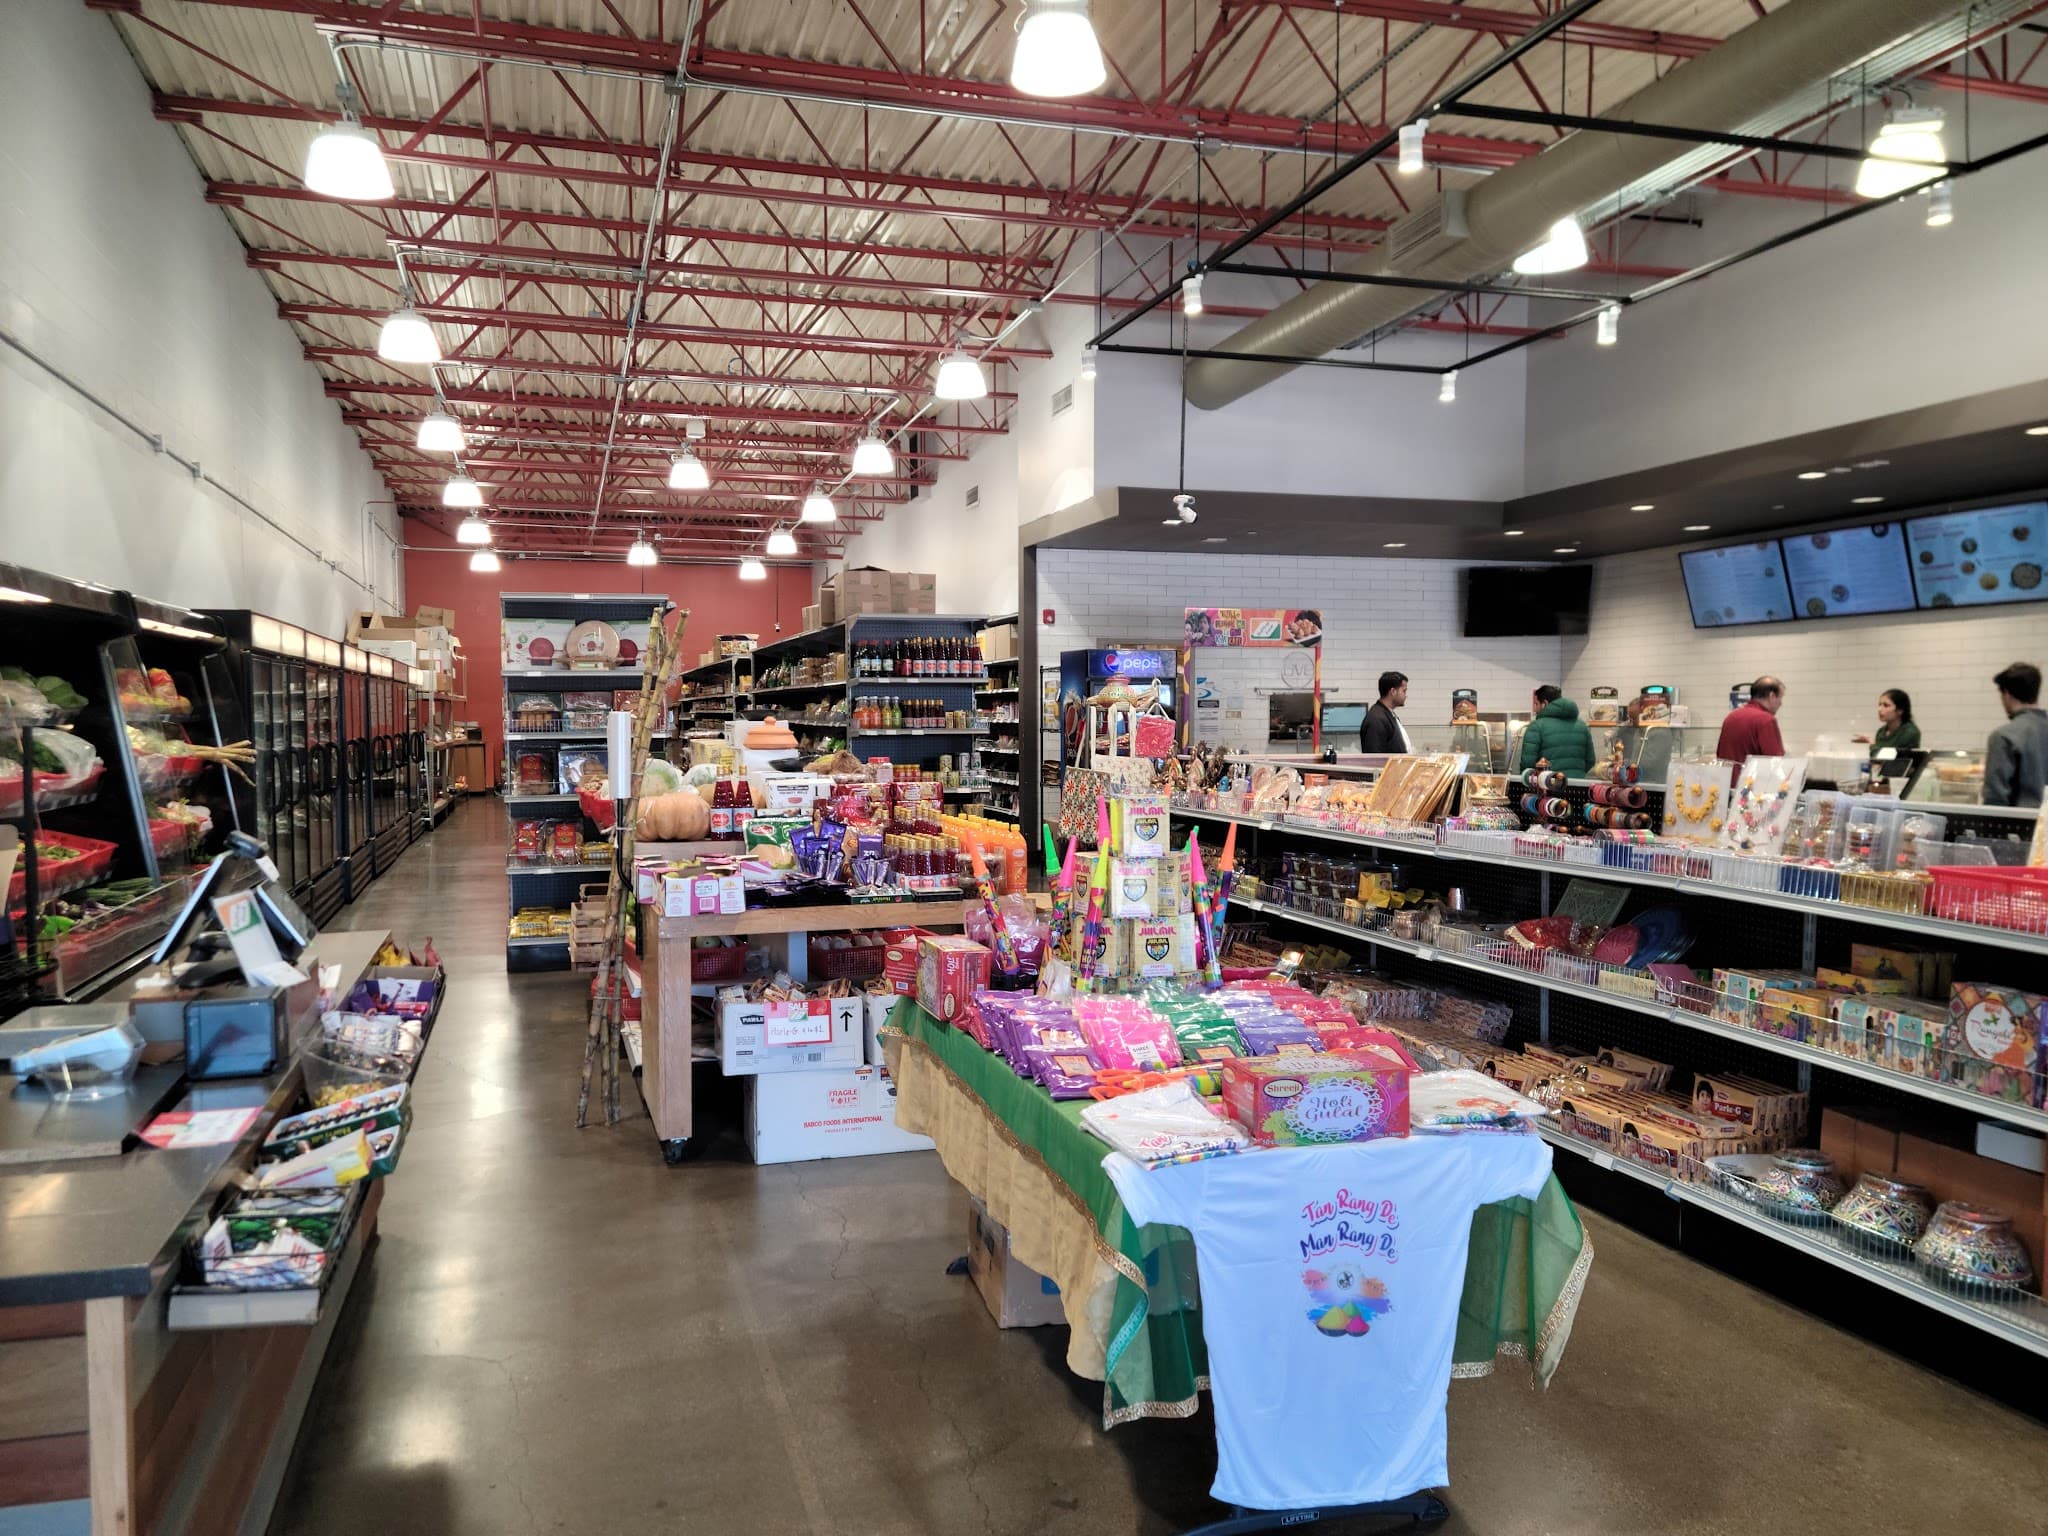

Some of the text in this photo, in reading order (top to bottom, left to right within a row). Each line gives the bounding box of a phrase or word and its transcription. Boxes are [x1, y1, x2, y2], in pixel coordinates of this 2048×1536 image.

[1122, 656, 1161, 671] pepsi
[788, 1002, 809, 1010] SALE
[829, 1089, 857, 1097] FRAGILE
[1267, 1083, 1300, 1095] Shreeji
[1309, 1095, 1352, 1108] Holi
[842, 1115, 882, 1124] INTERNATIONAL
[1305, 1106, 1362, 1121] Gulal
[1303, 1188, 1396, 1225] Tan Rang De
[1300, 1221, 1396, 1259] Man Rang De
[1285, 1512, 1317, 1524] LIFETIME
